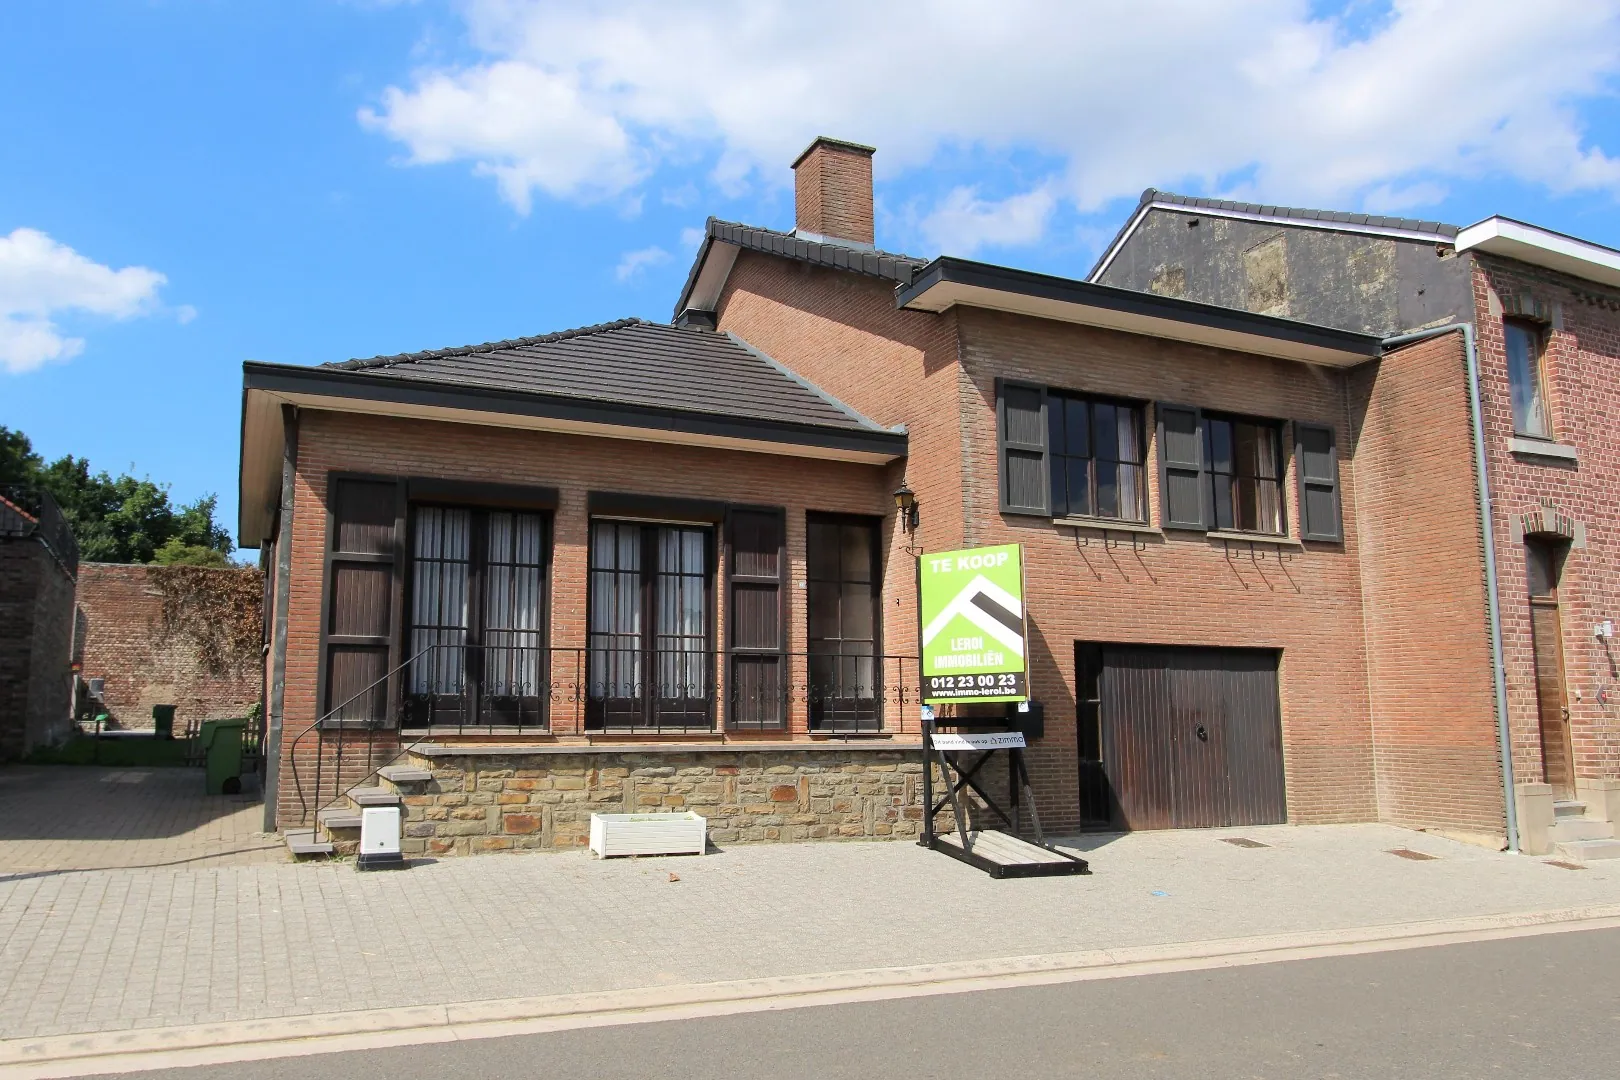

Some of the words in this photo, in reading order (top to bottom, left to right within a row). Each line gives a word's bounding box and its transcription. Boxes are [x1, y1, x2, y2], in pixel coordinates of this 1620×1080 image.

[929, 558, 952, 573] TE
[957, 552, 1009, 570] KOOP
[951, 636, 983, 651] LEROI
[931, 677, 954, 688] 012
[958, 676, 974, 687] 23
[978, 675, 994, 686] 00
[998, 674, 1016, 686] 23
